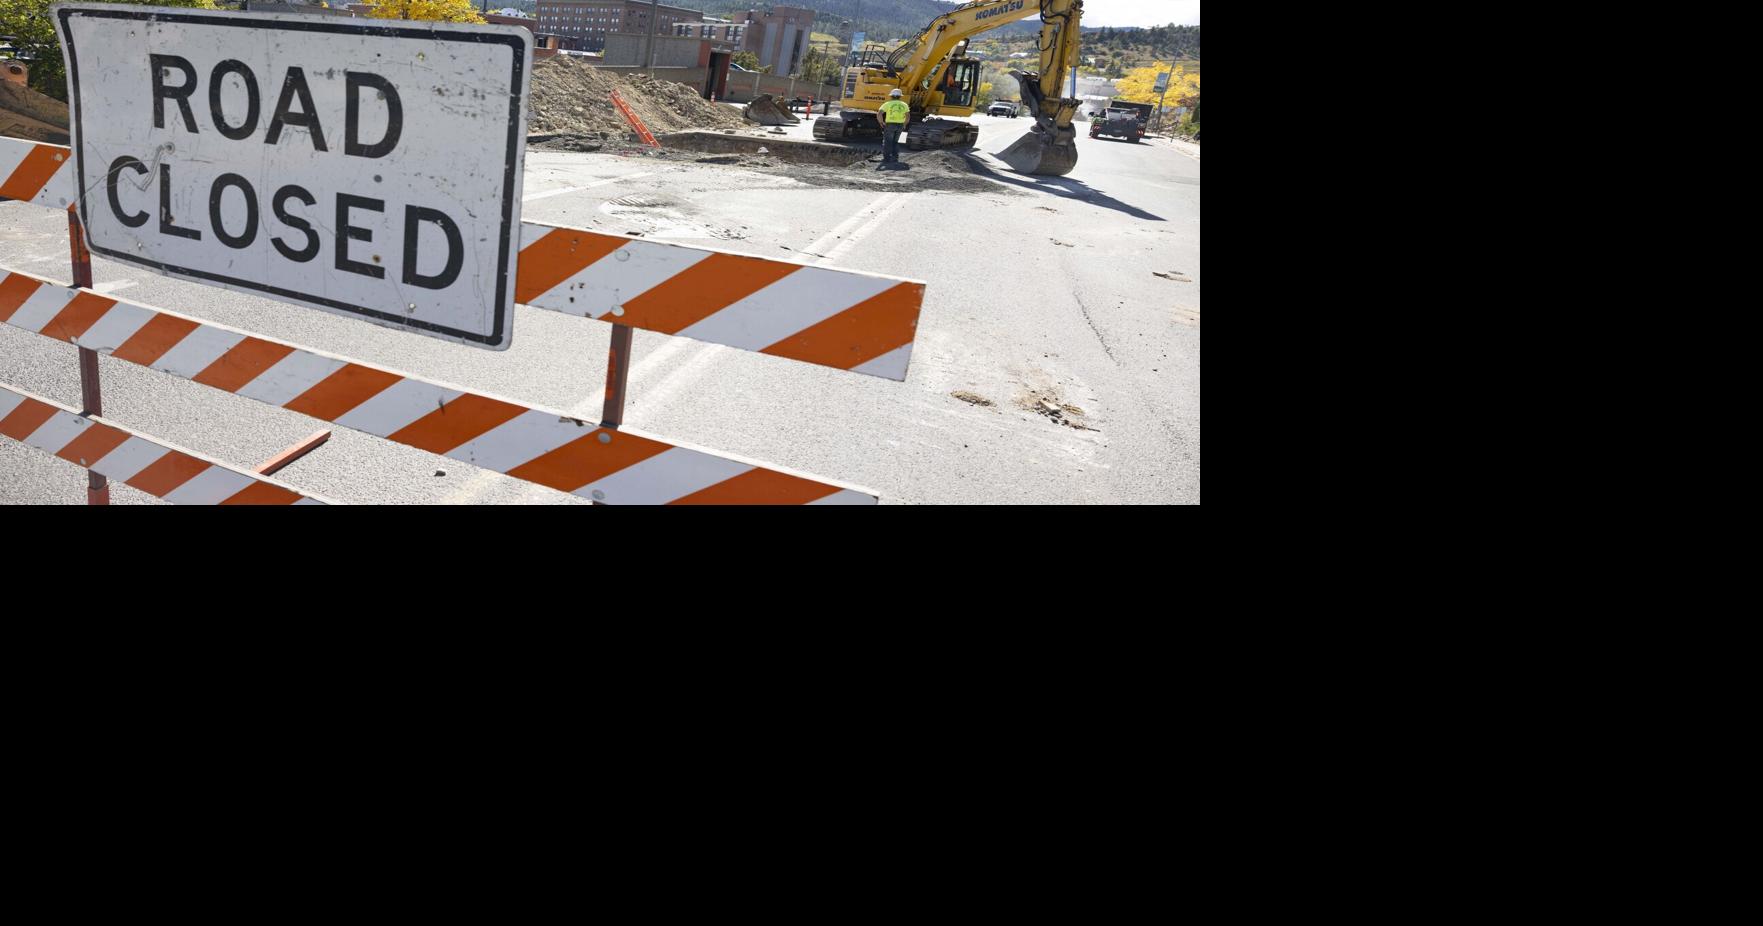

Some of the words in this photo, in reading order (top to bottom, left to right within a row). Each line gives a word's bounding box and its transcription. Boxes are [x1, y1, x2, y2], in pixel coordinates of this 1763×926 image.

[975, 0, 1024, 20] KOMATSU
[149, 53, 403, 158] ROAD
[106, 155, 464, 290] CLOSED
